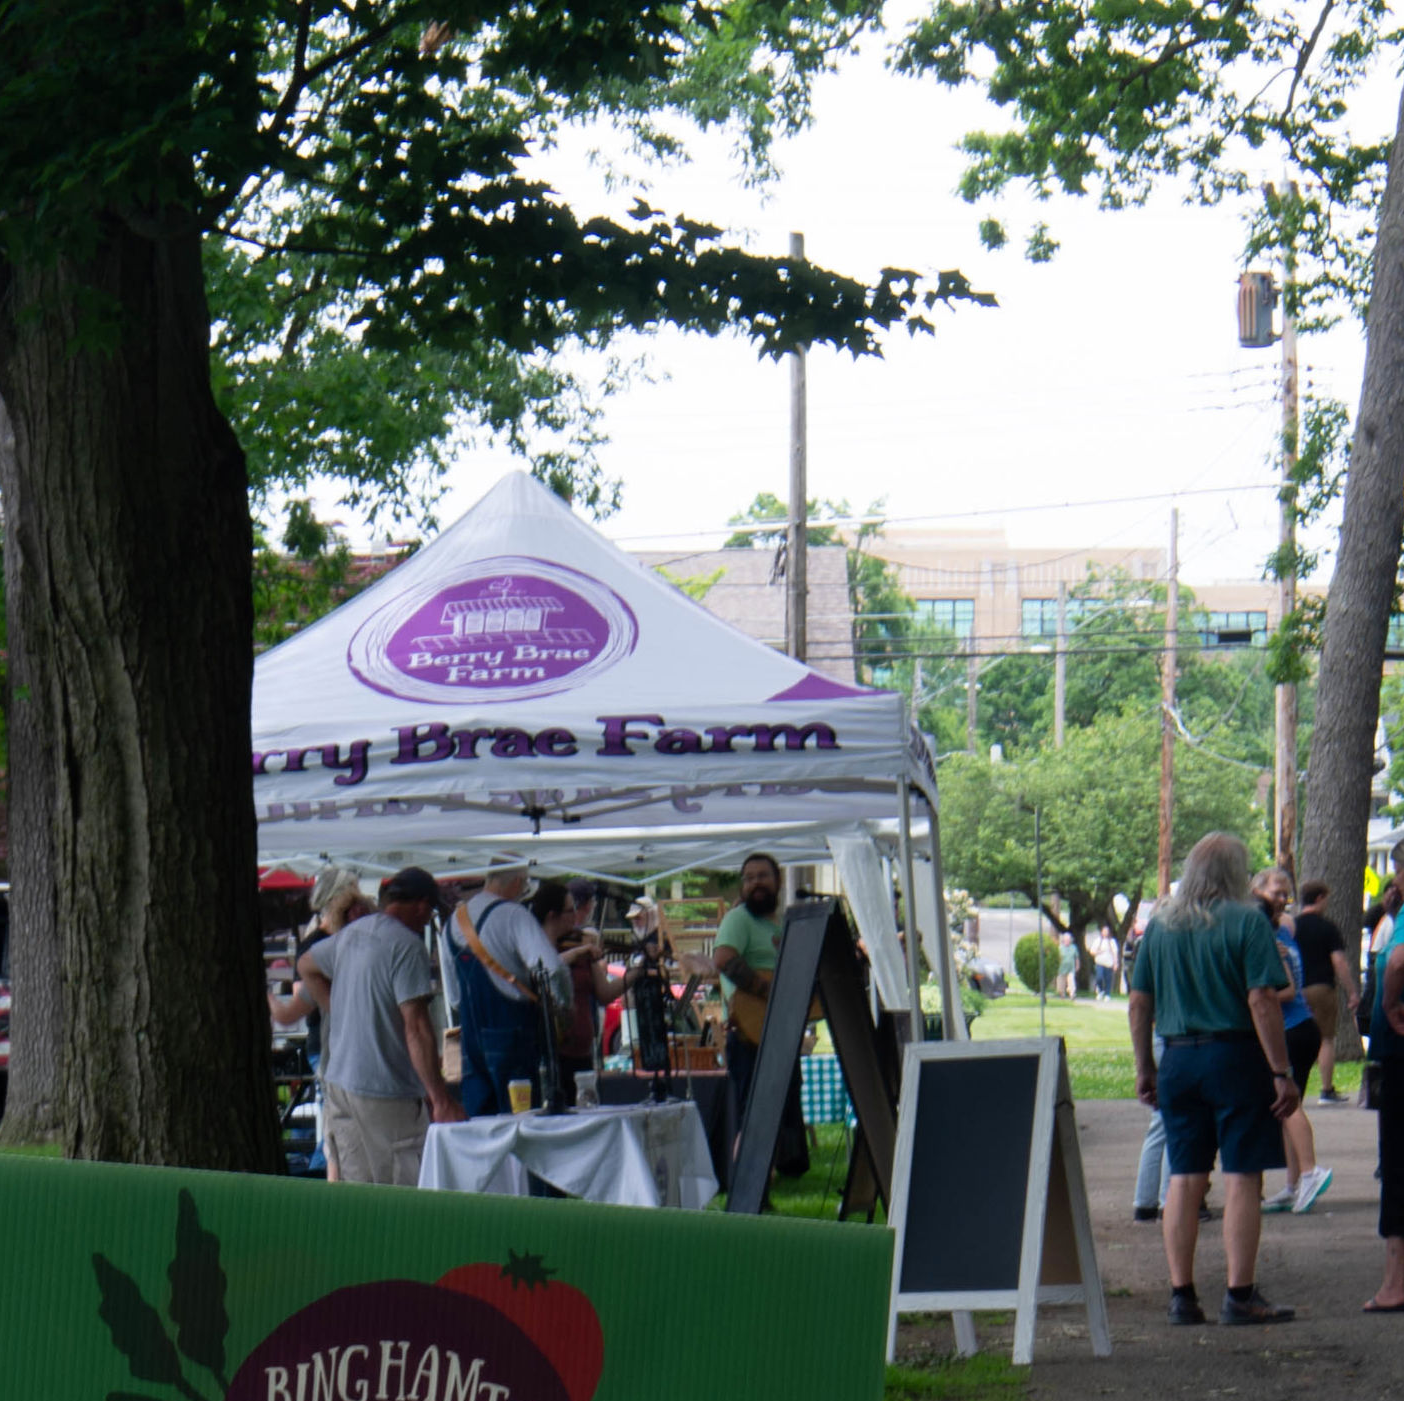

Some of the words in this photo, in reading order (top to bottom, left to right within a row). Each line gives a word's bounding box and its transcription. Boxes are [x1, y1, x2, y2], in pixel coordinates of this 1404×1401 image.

[407, 649, 505, 669] Berry
[512, 644, 590, 661] Brae
[445, 665, 546, 683] Farm
[252, 739, 372, 786] rry
[390, 721, 579, 765] Brae
[596, 713, 842, 756] Farm
